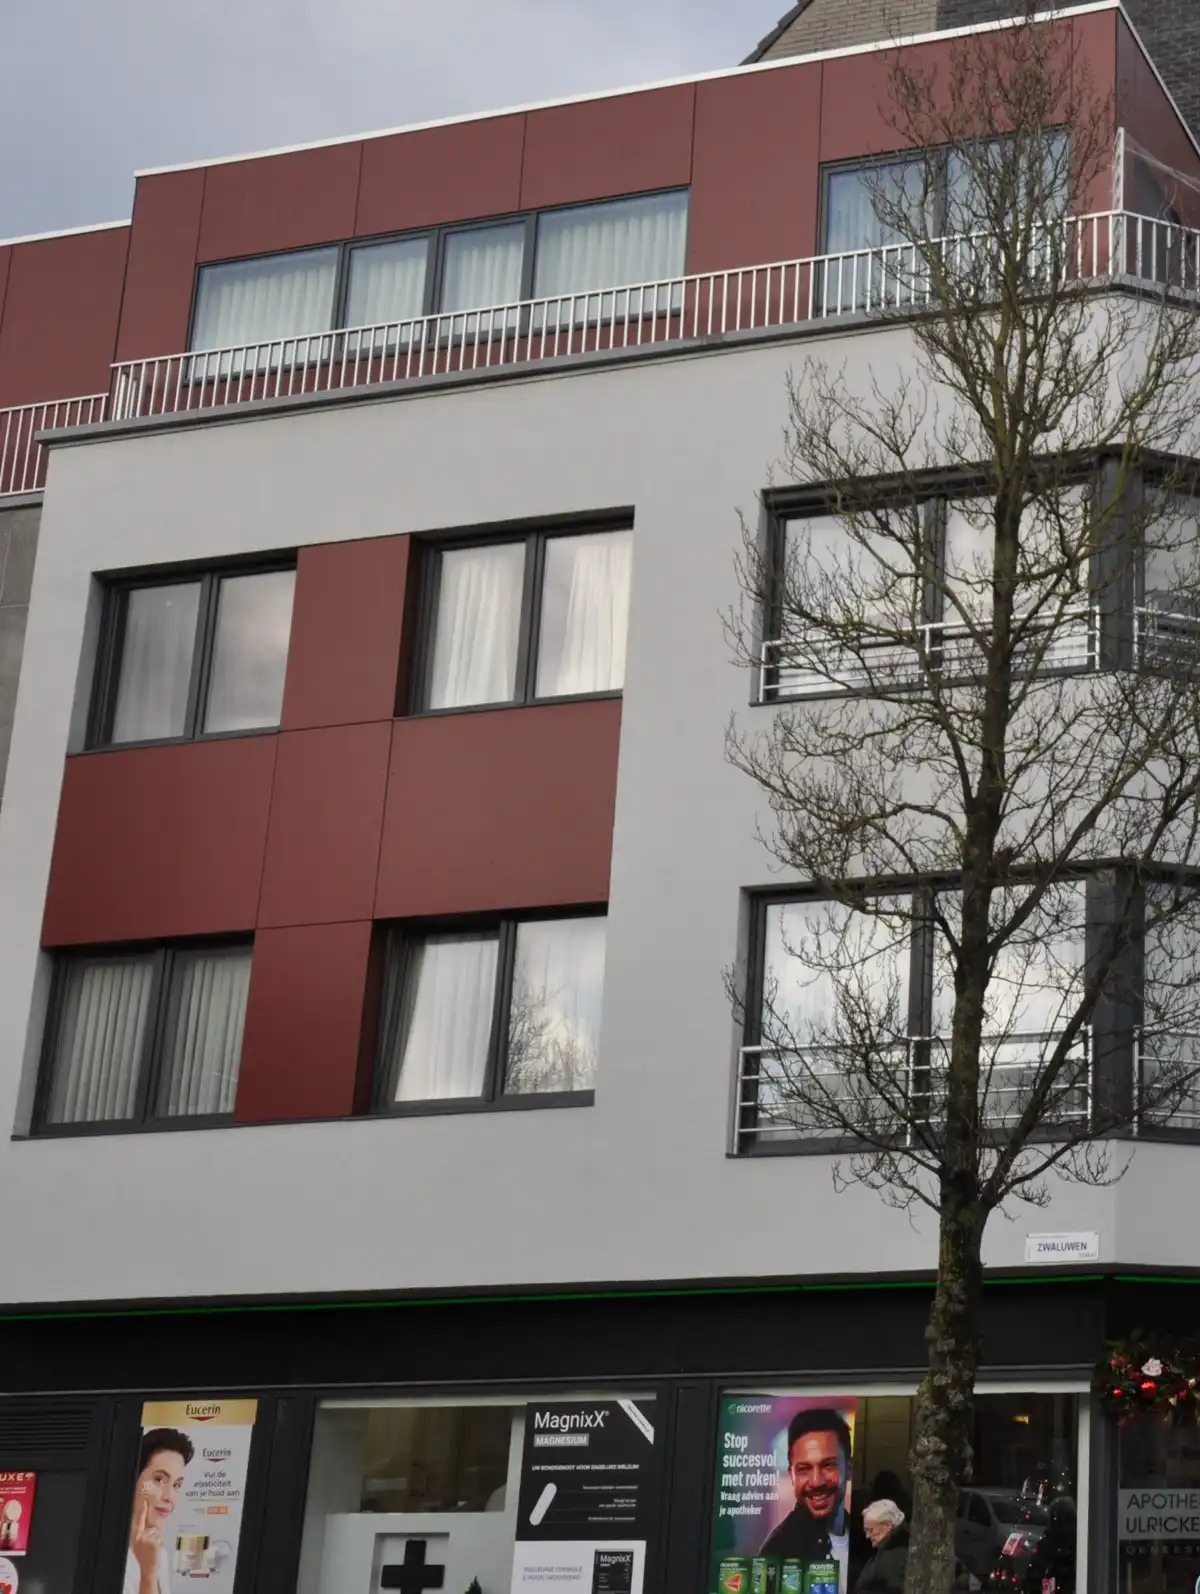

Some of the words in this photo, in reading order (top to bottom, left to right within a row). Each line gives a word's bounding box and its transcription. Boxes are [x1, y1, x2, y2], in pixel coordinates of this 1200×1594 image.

[1037, 1242, 1087, 1252] ZWALUWEN
[186, 1404, 221, 1415] Eucerin
[736, 1404, 771, 1413] nicorette
[534, 1411, 605, 1432] MagnixX
[536, 1435, 587, 1445] MAGNESIUM
[724, 1432, 748, 1452] Stop
[202, 1448, 231, 1458] Eucerin
[723, 1450, 777, 1468] succesvol
[721, 1471, 743, 1486] met
[745, 1469, 779, 1487] roken!
[720, 1491, 740, 1502] Vraag
[741, 1491, 764, 1501] advies
[765, 1492, 778, 1501] aan
[719, 1505, 726, 1517] je
[727, 1505, 762, 1517] apotheker
[1126, 1516, 1200, 1533] ULRICKE
[600, 1554, 632, 1564] MagnixX
